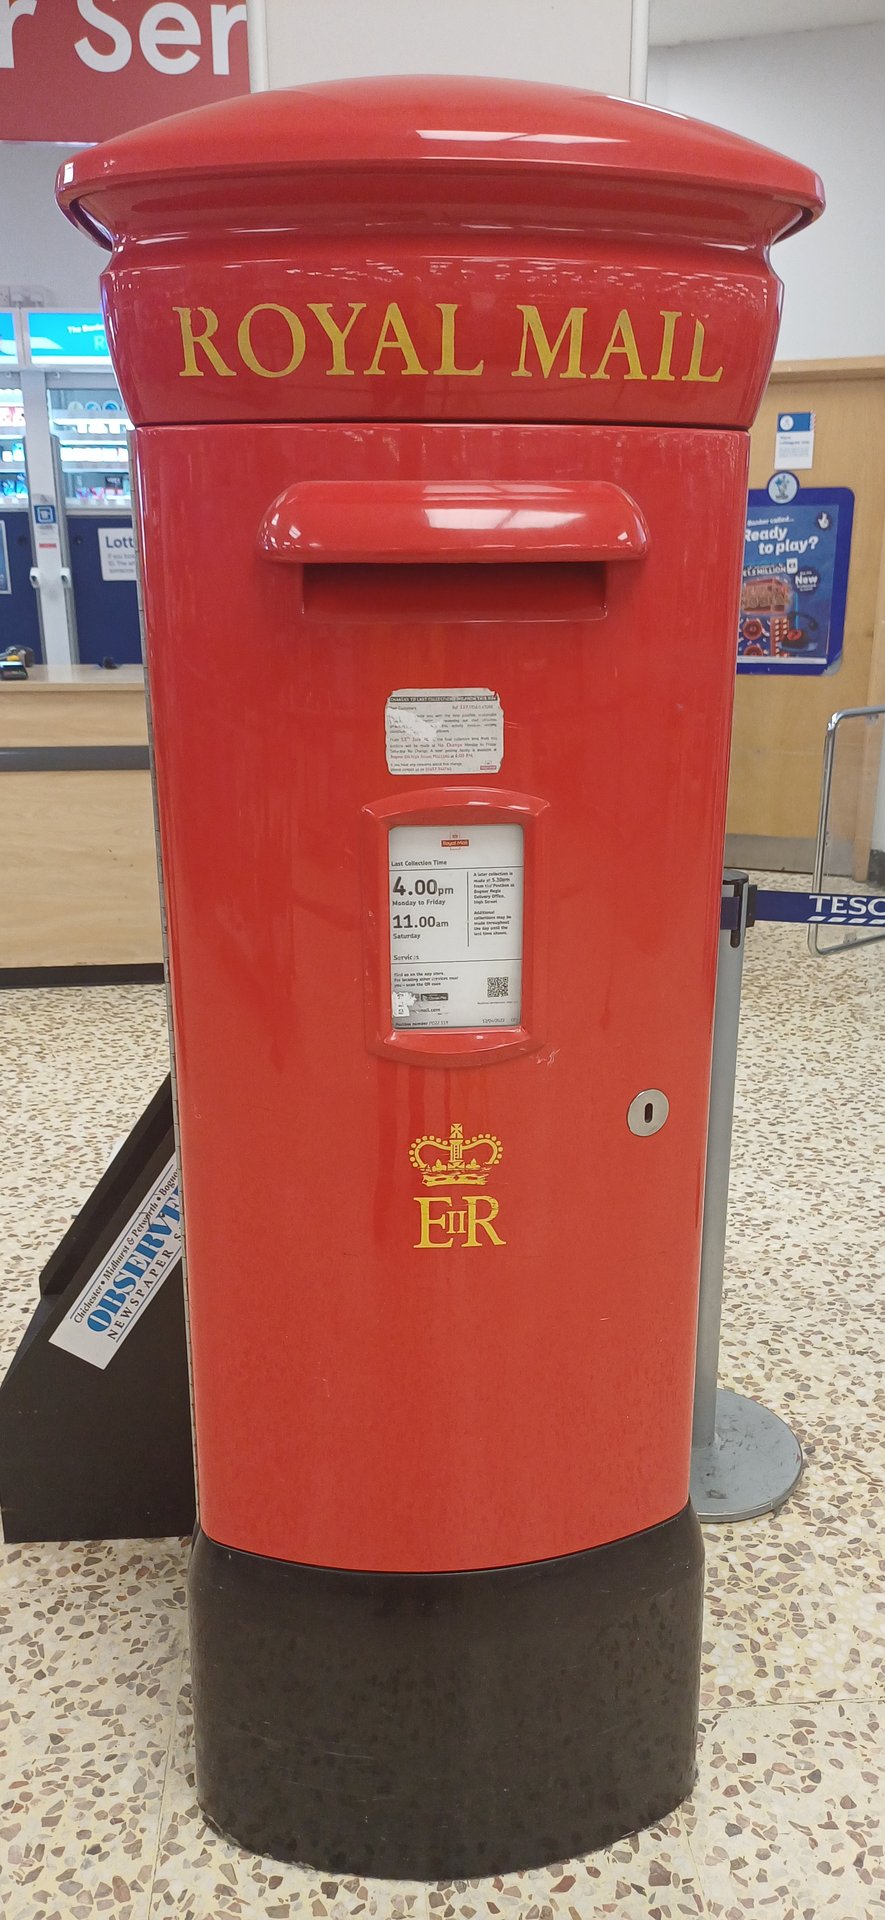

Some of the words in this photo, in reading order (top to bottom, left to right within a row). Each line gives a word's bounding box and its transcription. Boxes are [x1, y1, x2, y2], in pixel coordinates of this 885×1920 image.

[74, 0, 247, 75] Ser
[172, 303, 484, 378] ROYAL
[511, 304, 723, 382] MAIL
[745, 526, 787, 541] Ready
[759, 542, 774, 555] to
[775, 536, 819, 556] play?
[392, 876, 454, 896] 4.00pm
[392, 914, 449, 928] 11.00am
[809, 895, 885, 916] TESC
[159, 1168, 179, 1196] Bogno
[131, 1202, 158, 1237] Petworth
[128, 1237, 135, 1246] &
[87, 1185, 180, 1333] OBSERVE
[103, 1245, 129, 1281] Midhurst
[74, 1285, 102, 1324] Chichester
[107, 1249, 174, 1340] NEWSPAPER
